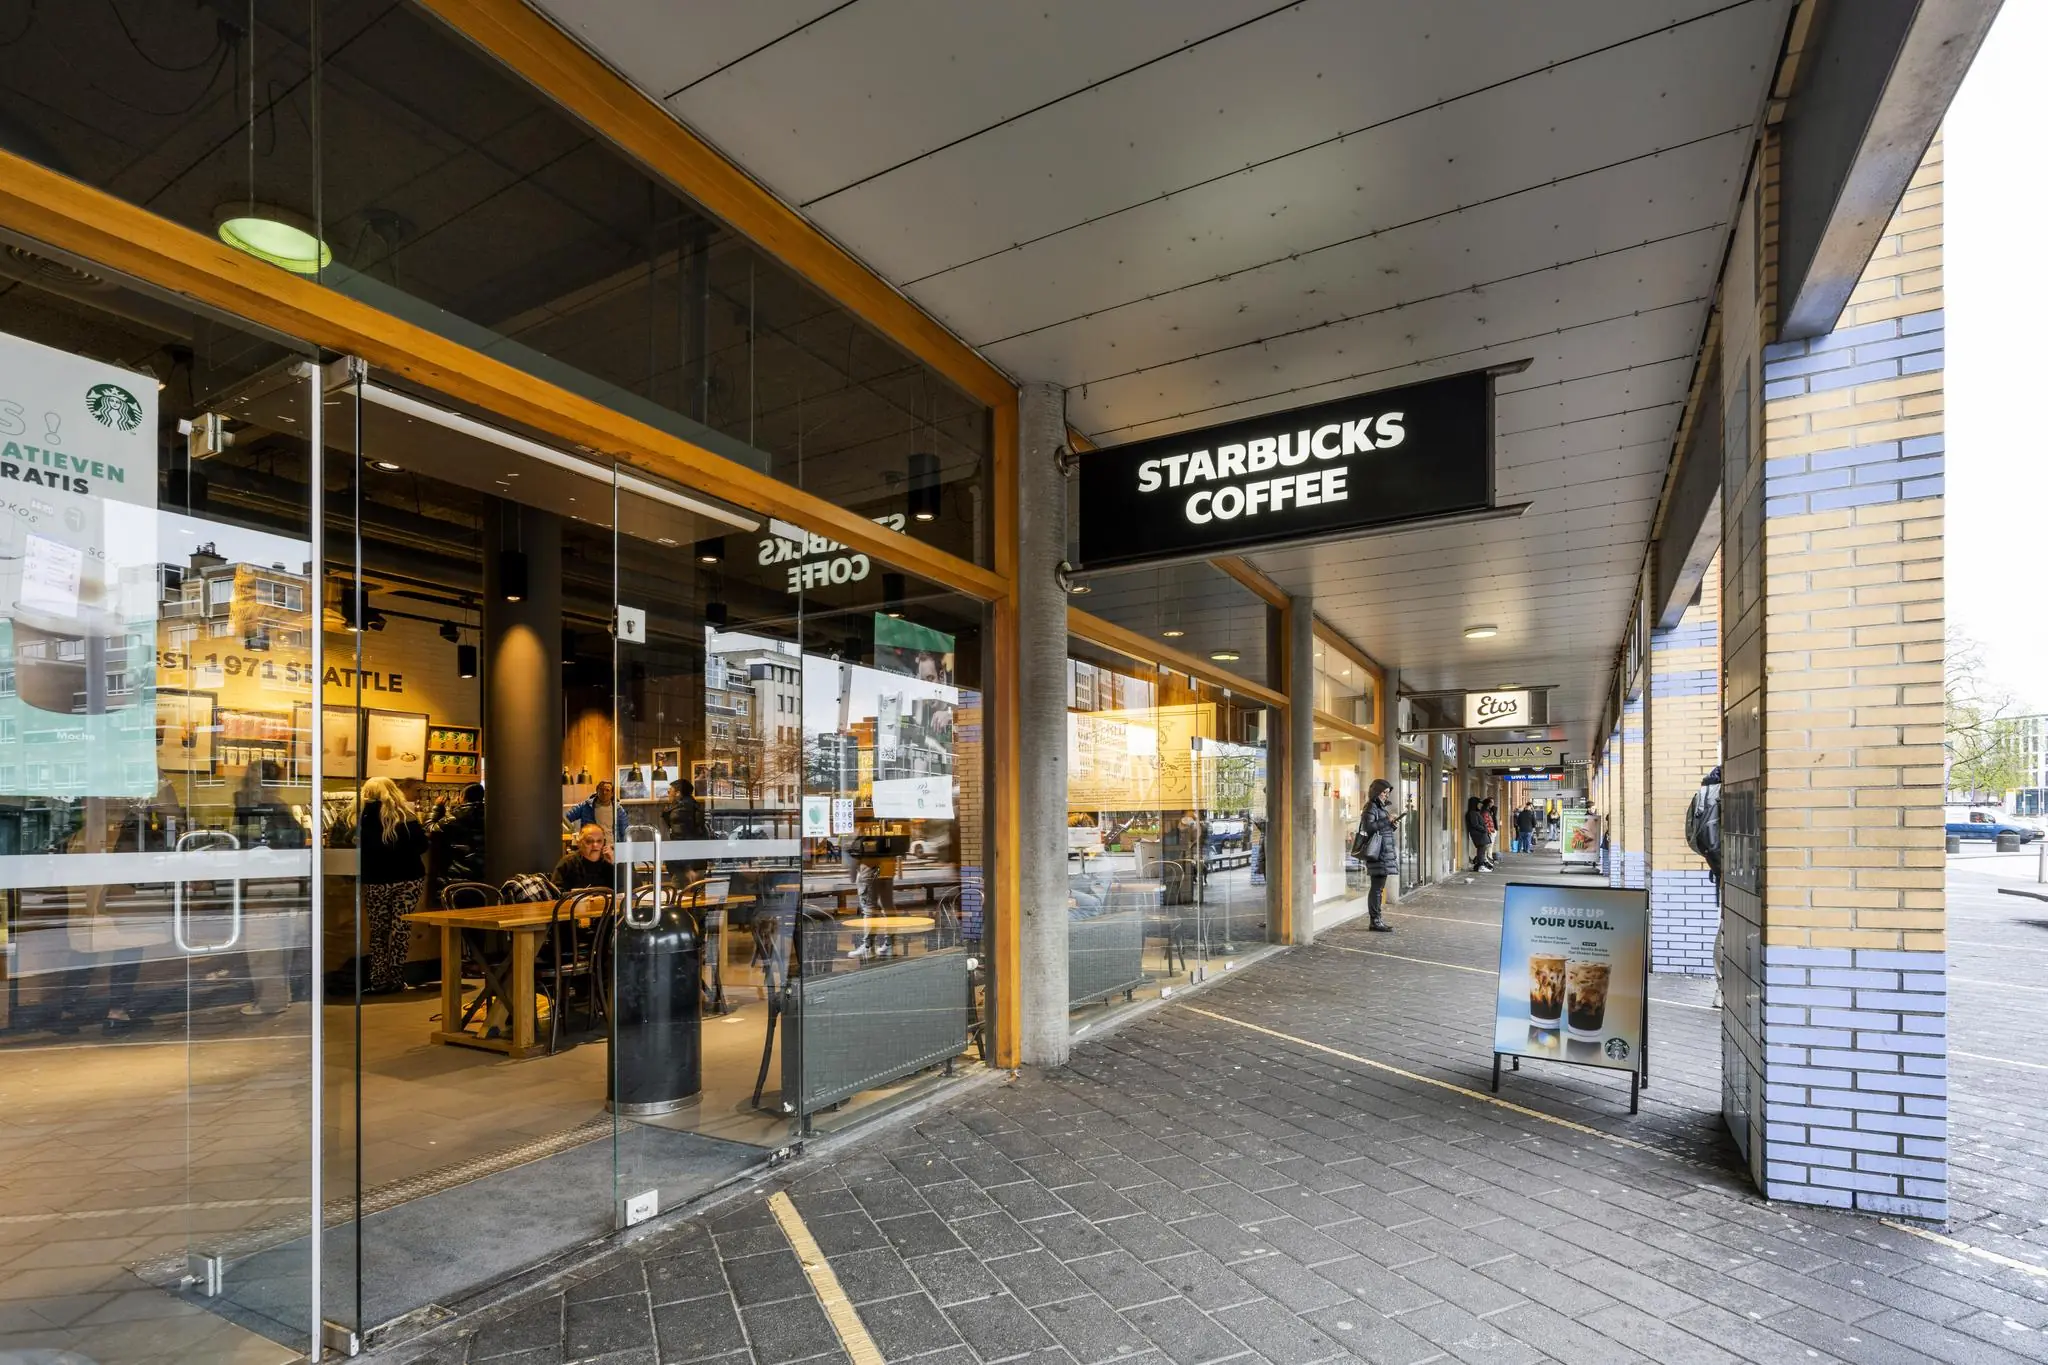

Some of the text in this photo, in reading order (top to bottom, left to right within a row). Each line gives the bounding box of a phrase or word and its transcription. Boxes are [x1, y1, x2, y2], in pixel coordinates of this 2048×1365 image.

[2, 441, 124, 483] ATIEVEN
[1138, 411, 1405, 492] STARBUCKS
[1, 462, 89, 495] RATIS
[1185, 466, 1349, 524] COFFEE
[204, 651, 278, 681] 1971
[1477, 695, 1517, 718] Etos
[56, 731, 95, 741] Mocha
[1482, 746, 1553, 758] JULIA'S
[1530, 916, 1614, 931] YOUR USUAL.
[1540, 906, 1604, 918] SHAKE UP
